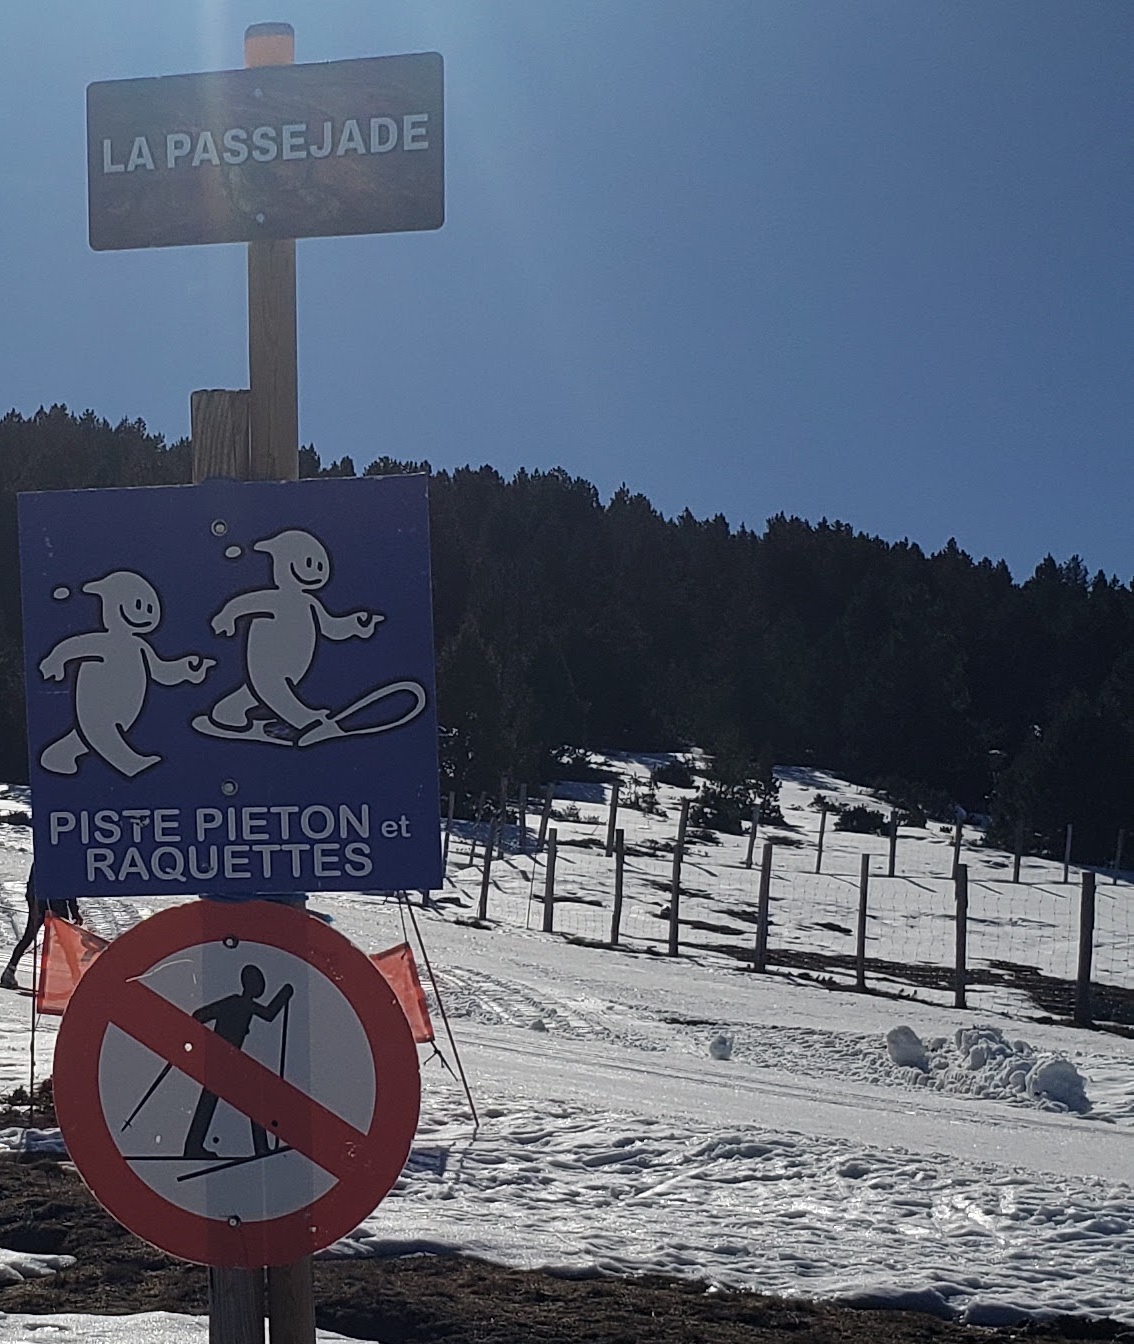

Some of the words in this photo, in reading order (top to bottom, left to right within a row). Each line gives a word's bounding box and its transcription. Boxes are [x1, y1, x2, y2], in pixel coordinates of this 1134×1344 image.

[102, 136, 155, 174] LA
[167, 113, 429, 168] PASSEJADE
[49, 809, 181, 845] PISTE
[196, 804, 370, 842] PIETON
[381, 815, 412, 838] et
[86, 843, 374, 882] RAQUETTES
